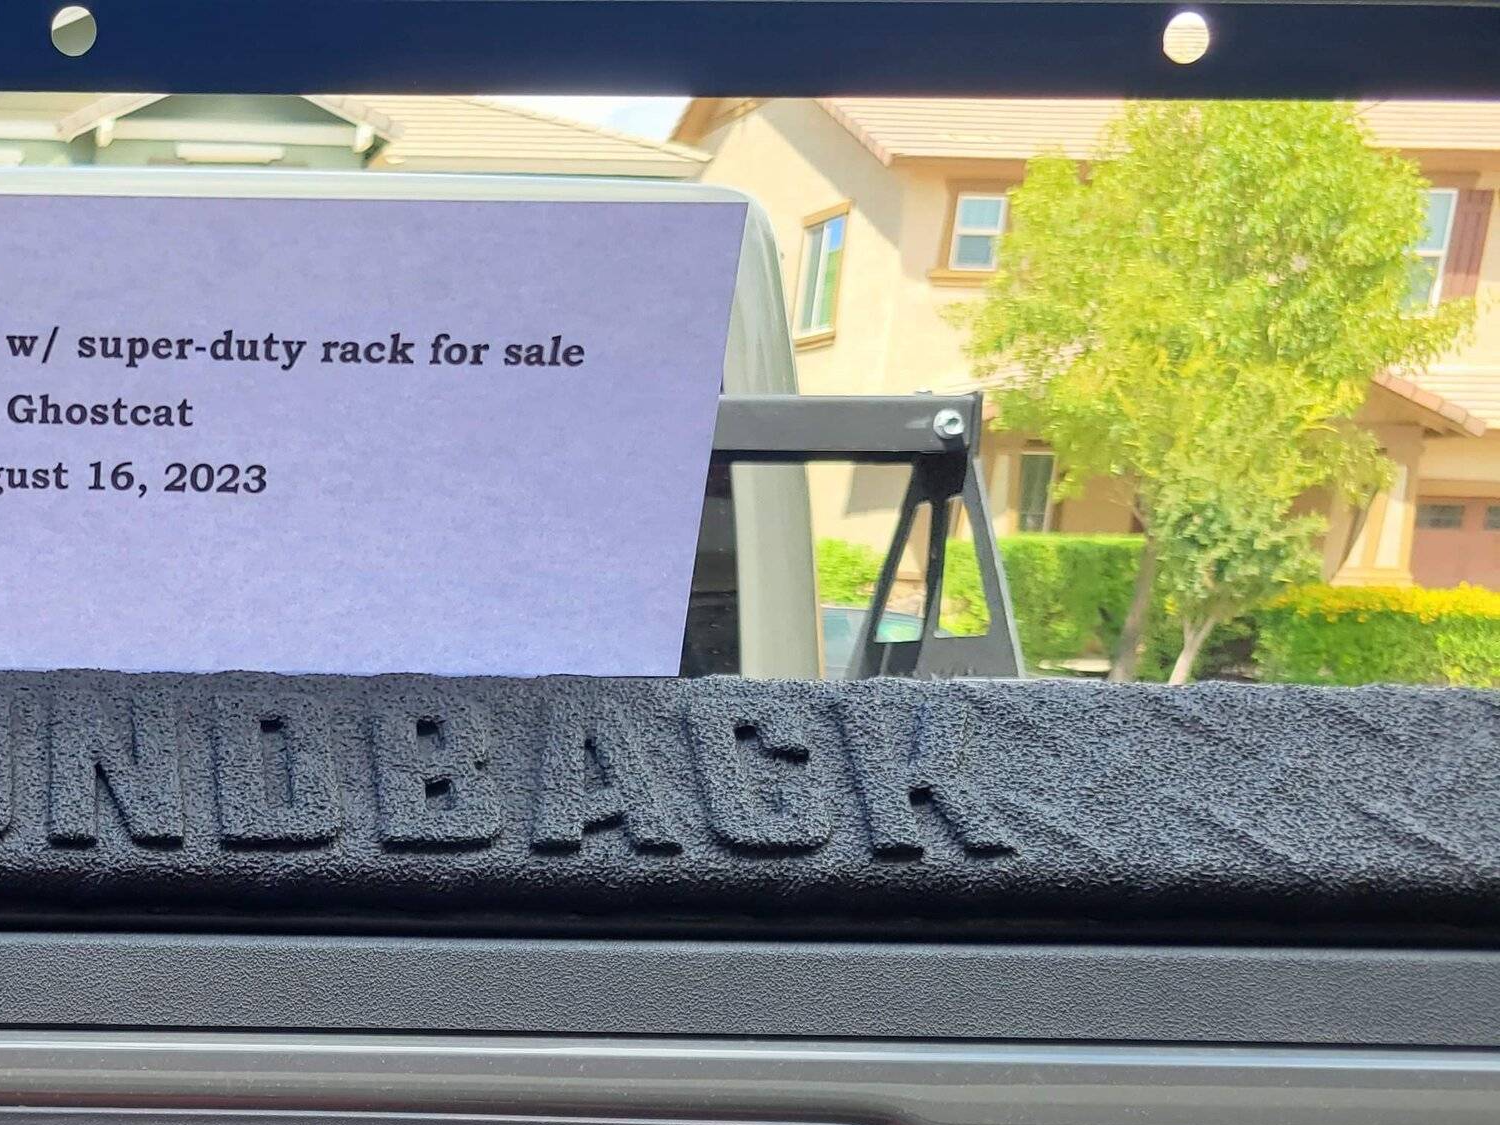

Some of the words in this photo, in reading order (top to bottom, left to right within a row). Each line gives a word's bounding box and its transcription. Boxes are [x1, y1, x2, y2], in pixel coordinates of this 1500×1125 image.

[5, 325, 60, 364] w/
[76, 328, 307, 371] super-duty
[319, 332, 415, 366] rack
[429, 333, 490, 366] for
[503, 334, 585, 368] sale
[6, 393, 195, 427] Ghostcat
[87, 460, 149, 499] 16,
[163, 461, 268, 495] 2023
